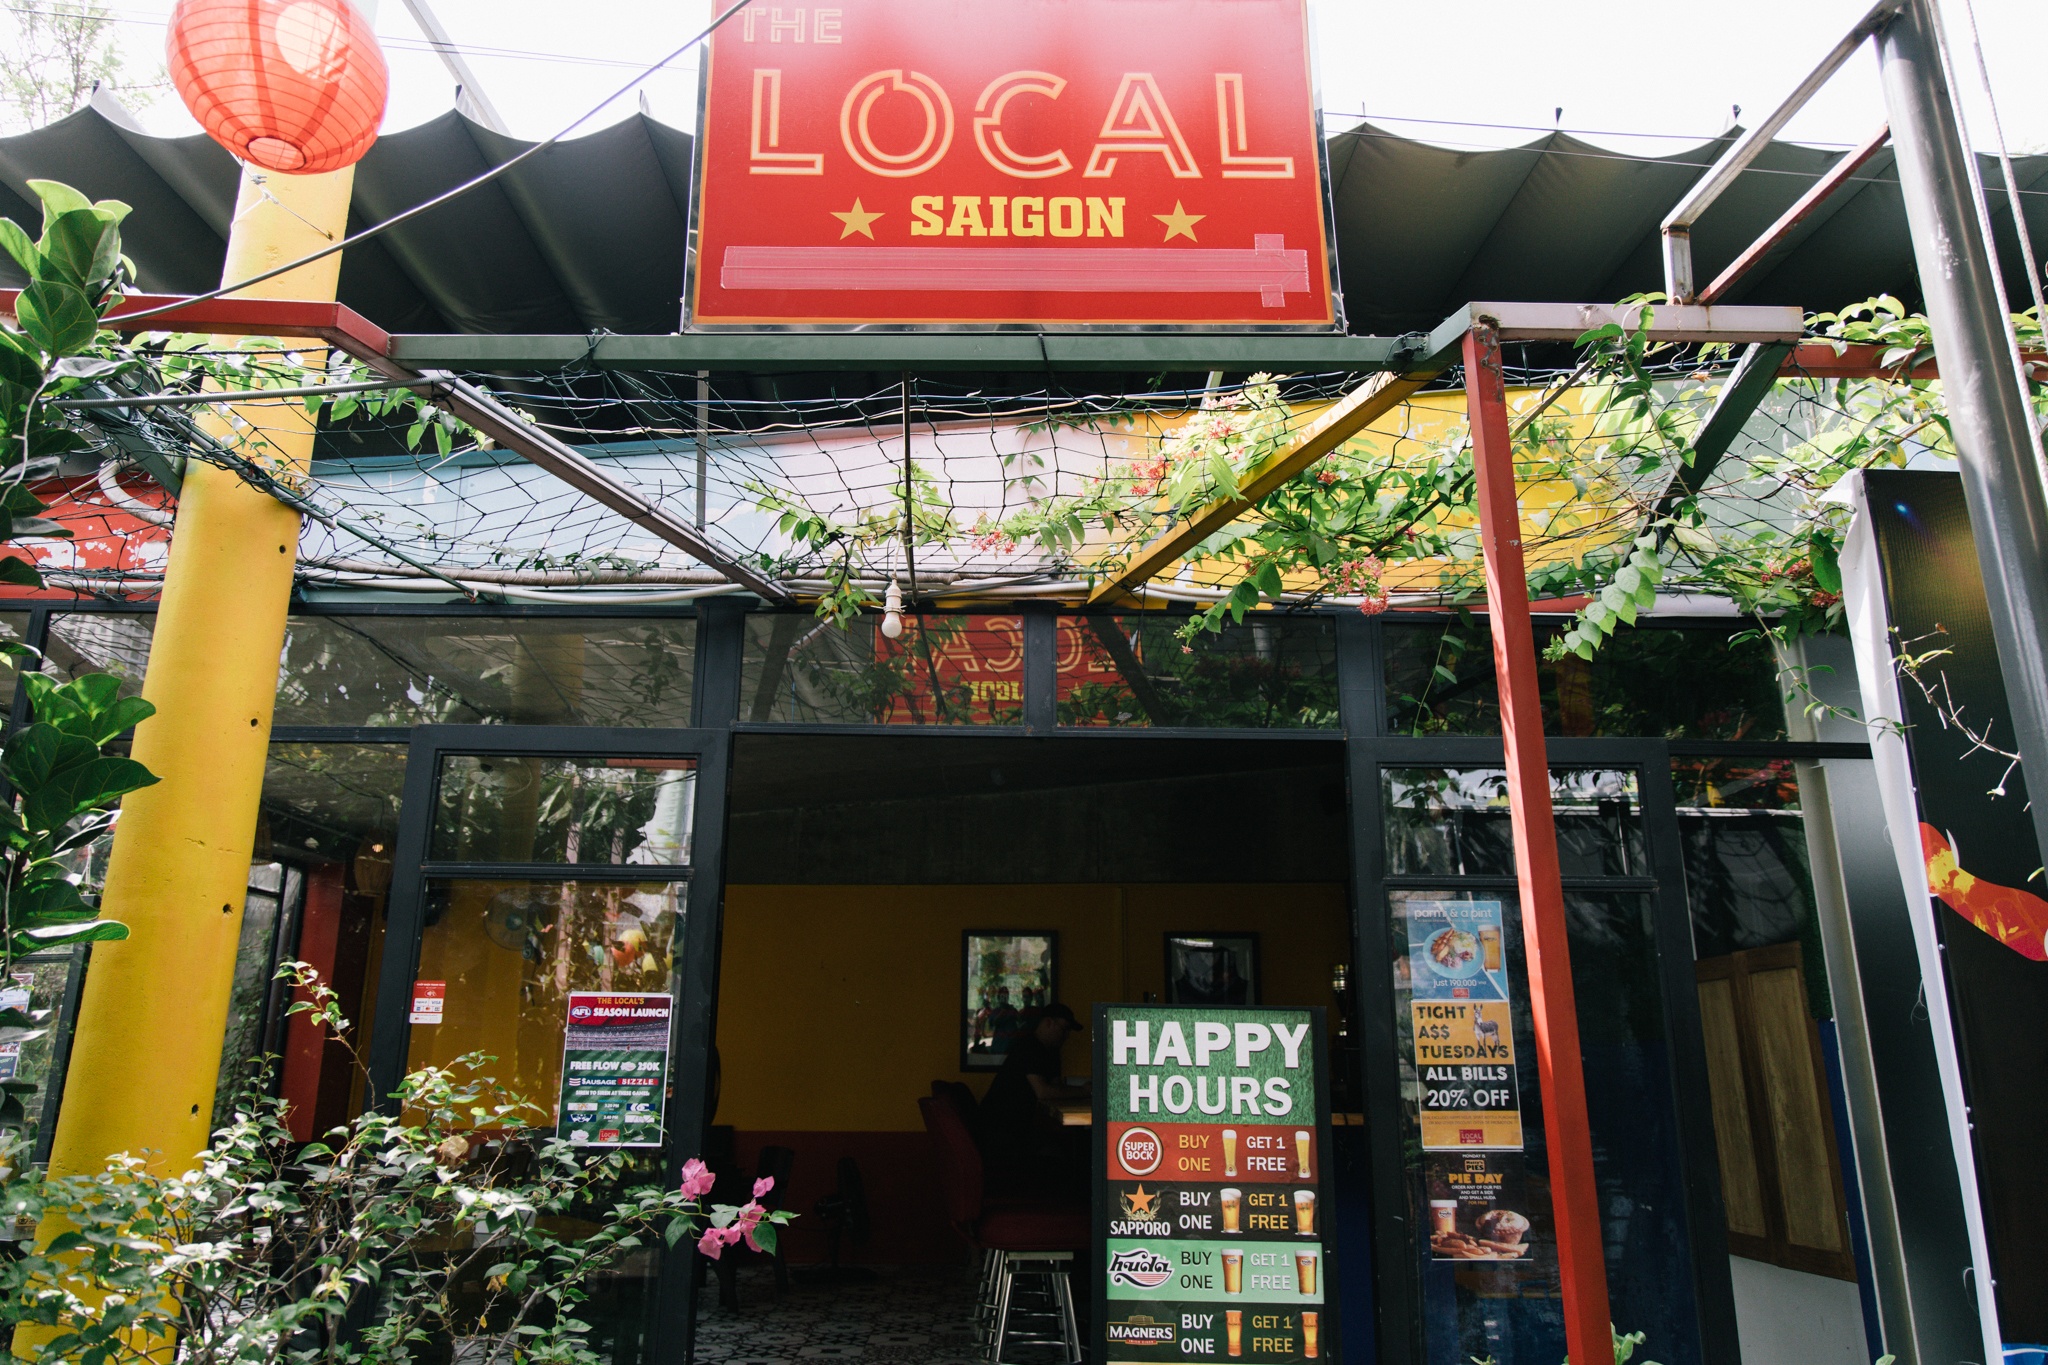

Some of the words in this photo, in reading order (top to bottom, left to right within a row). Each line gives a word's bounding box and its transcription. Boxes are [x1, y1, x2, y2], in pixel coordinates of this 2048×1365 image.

[737, 7, 843, 44] THE
[748, 68, 1296, 179] LOCAL
[910, 195, 1127, 238] SAIGON
[1449, 908, 1458, 918] &
[1460, 910, 1469, 918] a
[1471, 908, 1493, 921] pint
[1433, 979, 1448, 988] just
[614, 997, 645, 1005] LOCAL'S
[571, 1008, 591, 1016] AFL
[593, 1007, 630, 1017] SEASON
[630, 1008, 669, 1017] LAUNCH
[1416, 1005, 1466, 1019] TIGHT
[1418, 1024, 1450, 1040] A$$
[1112, 1020, 1310, 1068] HAPPY
[1419, 1045, 1509, 1058] TUESDAYS
[570, 1061, 592, 1070] FREE
[592, 1061, 620, 1070] FLOW
[637, 1061, 661, 1071] 250K
[1425, 1067, 1457, 1081] ALL
[1461, 1066, 1508, 1081] BILLS
[581, 1077, 617, 1086] SAUSAGE
[621, 1078, 654, 1086] SIZZLE
[1129, 1074, 1293, 1116] HOURS
[1427, 1089, 1468, 1107] 20%
[1473, 1089, 1510, 1106] OFF
[1124, 1141, 1155, 1152] SUPER
[1179, 1134, 1210, 1149] BUY
[1246, 1136, 1272, 1149] GET
[1276, 1137, 1286, 1149] 1
[1126, 1150, 1154, 1161] BOCK
[1178, 1157, 1211, 1171] ONE
[1247, 1157, 1287, 1171] FREE
[1448, 1173, 1472, 1184] PIE
[1474, 1173, 1504, 1184] DAY
[1179, 1191, 1211, 1207] BUY
[1248, 1193, 1275, 1206] GET
[1278, 1193, 1288, 1207] 1
[1110, 1220, 1171, 1236] SAPPORO
[1179, 1214, 1212, 1230] ONE
[1249, 1214, 1289, 1230] FREE
[1181, 1251, 1213, 1265] BUY
[1250, 1253, 1277, 1267] GET
[1281, 1253, 1290, 1267] 1
[1180, 1274, 1213, 1289] ONE
[1251, 1274, 1291, 1290] FREE
[1181, 1314, 1214, 1329] BUY
[1252, 1315, 1279, 1329] GET
[1283, 1315, 1293, 1329] 1
[1109, 1325, 1173, 1339] MAGNERS
[1181, 1337, 1215, 1353] ONE
[1253, 1337, 1294, 1353] FREE
